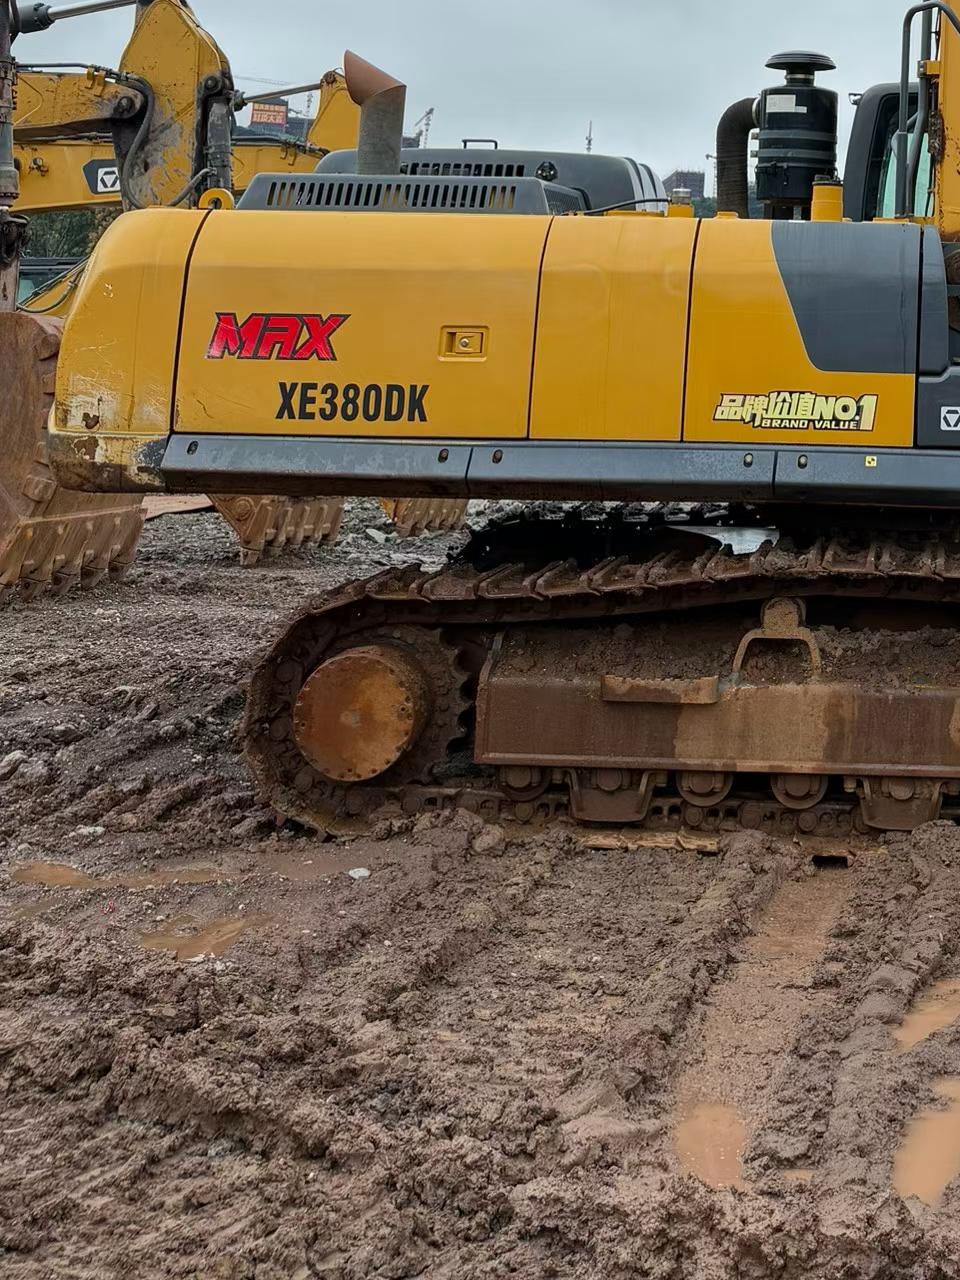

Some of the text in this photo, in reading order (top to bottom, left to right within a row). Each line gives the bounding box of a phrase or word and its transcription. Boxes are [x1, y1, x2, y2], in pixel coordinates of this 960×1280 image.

[204, 312, 352, 361] MAX
[275, 381, 430, 423] XE380DK
[761, 420, 858, 430] BRAND VALUE
